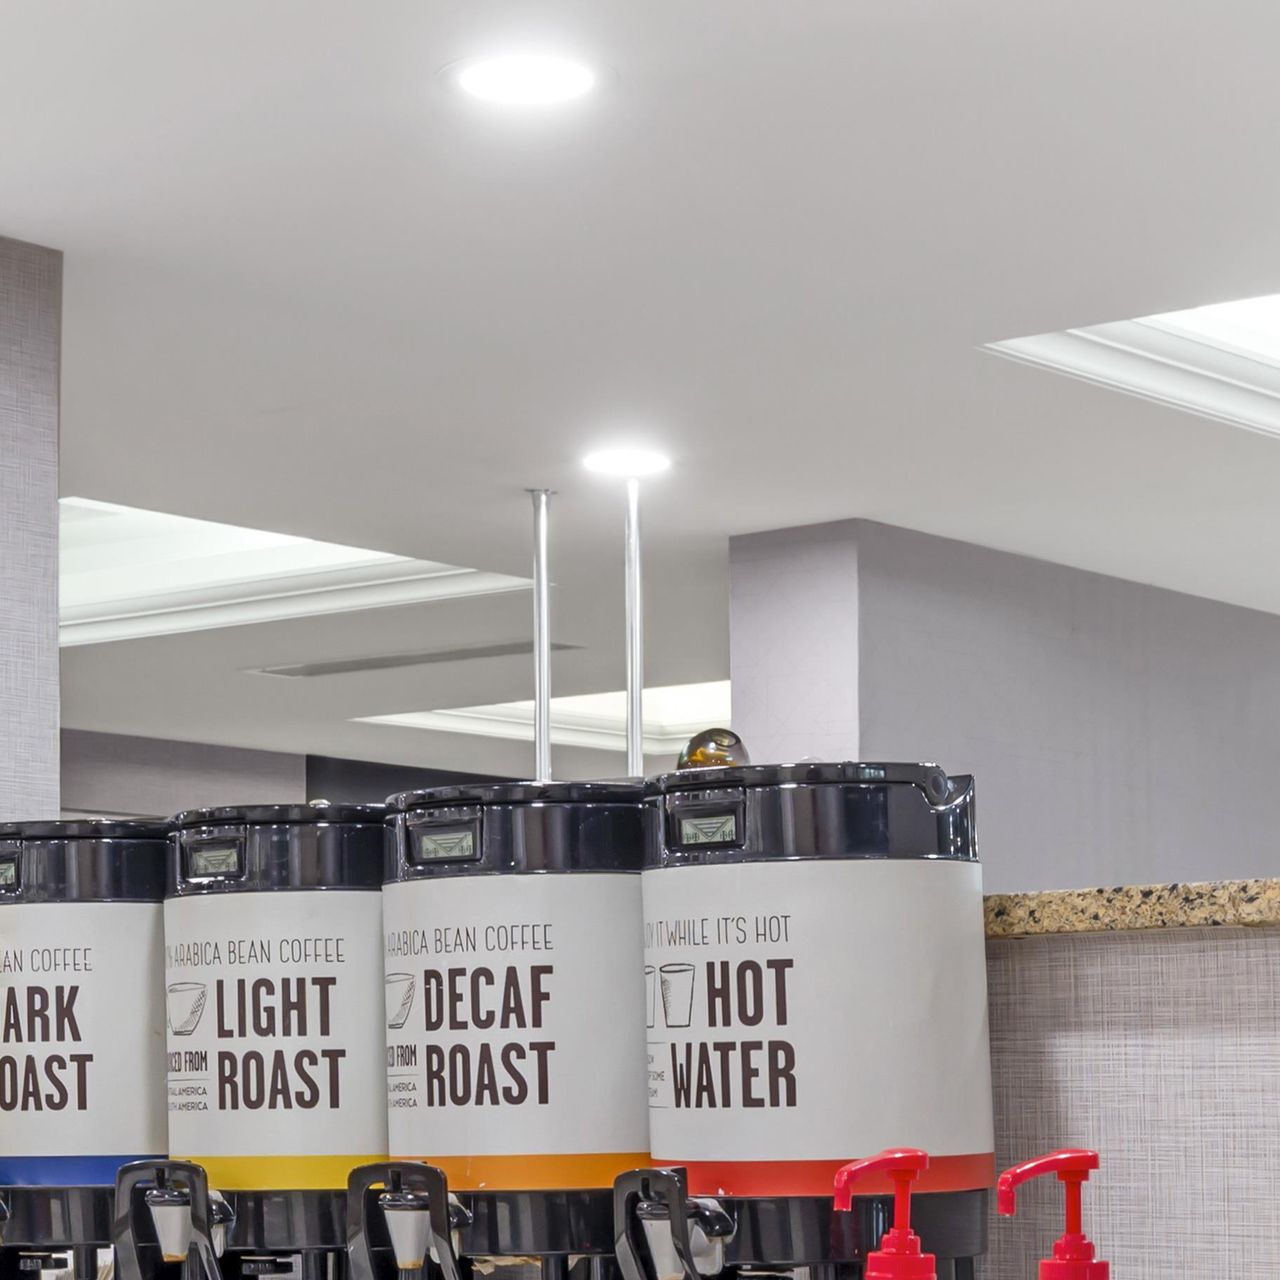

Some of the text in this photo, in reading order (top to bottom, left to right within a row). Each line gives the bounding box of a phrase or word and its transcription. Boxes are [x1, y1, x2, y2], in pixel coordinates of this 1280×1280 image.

[174, 942, 222, 967] ARABICA
[228, 939, 271, 965] BEAN
[279, 937, 345, 963] COFFEE
[435, 926, 476, 954] BEAN
[485, 923, 553, 951] COFFEE
[665, 918, 710, 947] WHILE
[717, 916, 747, 945] IT'S
[756, 914, 791, 943] HOT
[30, 947, 93, 973] COFFEE
[216, 976, 337, 1039] LIGHT
[424, 965, 554, 1032] DECAF
[706, 958, 794, 1028] HOT
[184, 1050, 208, 1072] FROM
[397, 1044, 417, 1067] FROM
[426, 1041, 556, 1107] ROAST
[671, 1040, 797, 1109] WATER
[217, 1049, 346, 1111] ROAST
